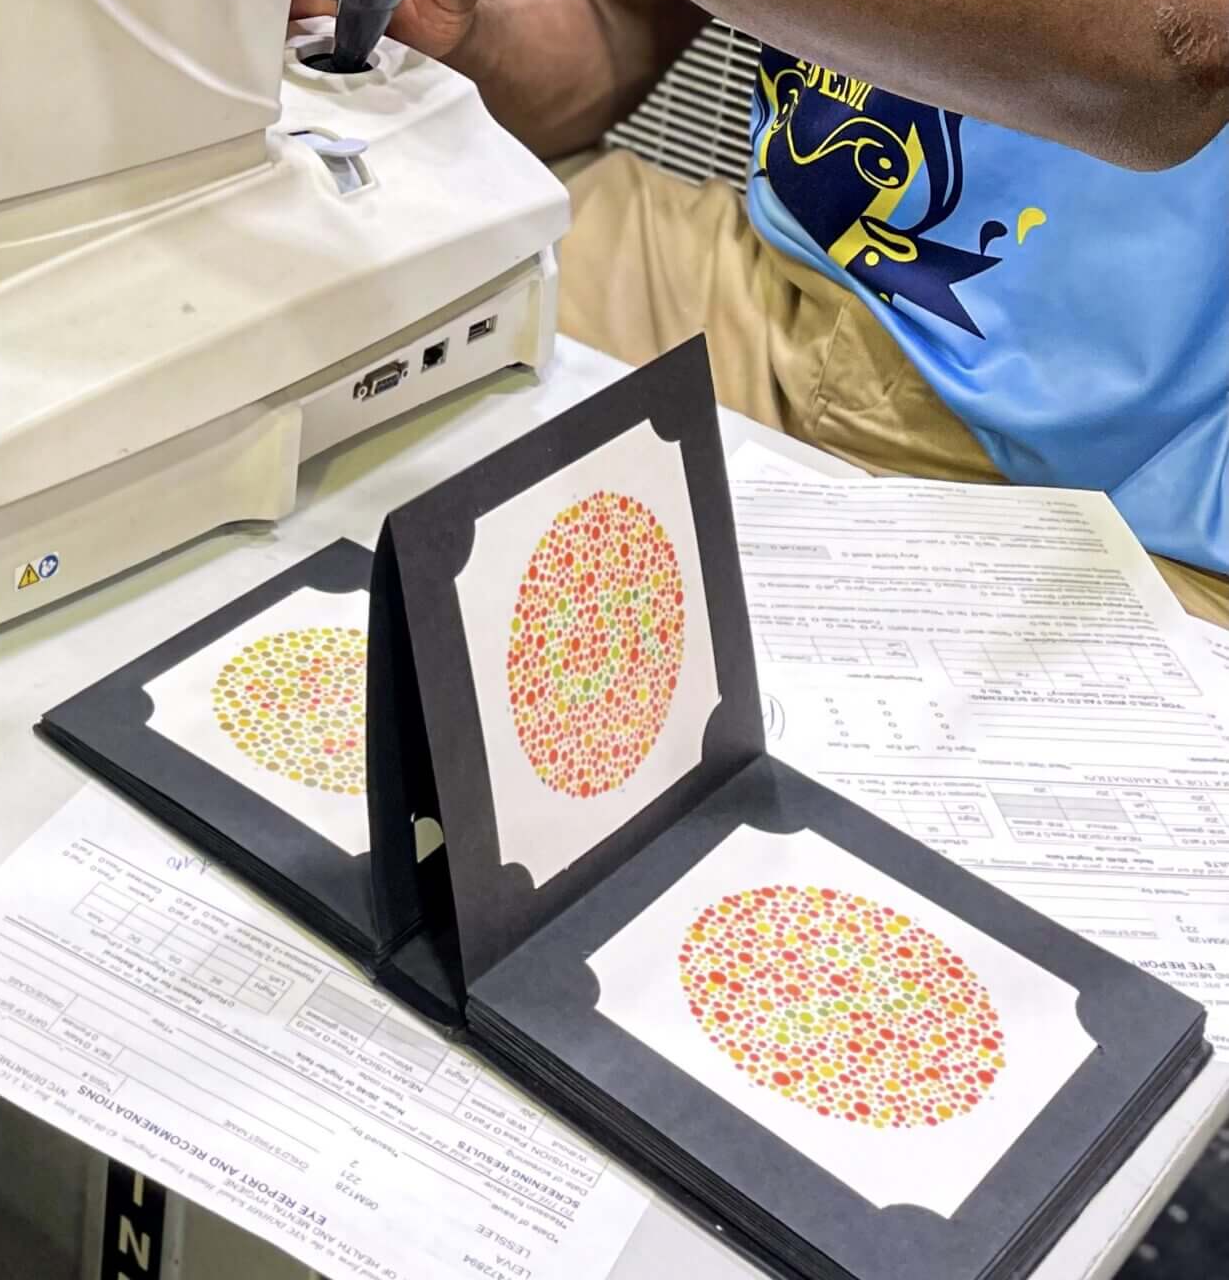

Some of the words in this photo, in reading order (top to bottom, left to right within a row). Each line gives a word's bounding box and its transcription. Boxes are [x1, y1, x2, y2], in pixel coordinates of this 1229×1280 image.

[1188, 961, 1217, 972] EYE
[77, 1085, 208, 1161] RECOMMENDATIONS
[208, 1156, 240, 1177] AND
[348, 1159, 360, 1169] 2
[457, 1140, 511, 1173] RESULTS
[223, 1177, 270, 1207] HYGIENE
[239, 1173, 298, 1209] REPORT
[339, 1169, 363, 1186] 221
[511, 1168, 581, 1209] SCREENING
[272, 1202, 312, 1231] MENTAL
[297, 1204, 328, 1227] EYE
[311, 1226, 337, 1244] AND
[474, 1223, 532, 1259] LESSLEE
[337, 1240, 381, 1270] HEALTH
[495, 1254, 533, 1280] LEIVA
